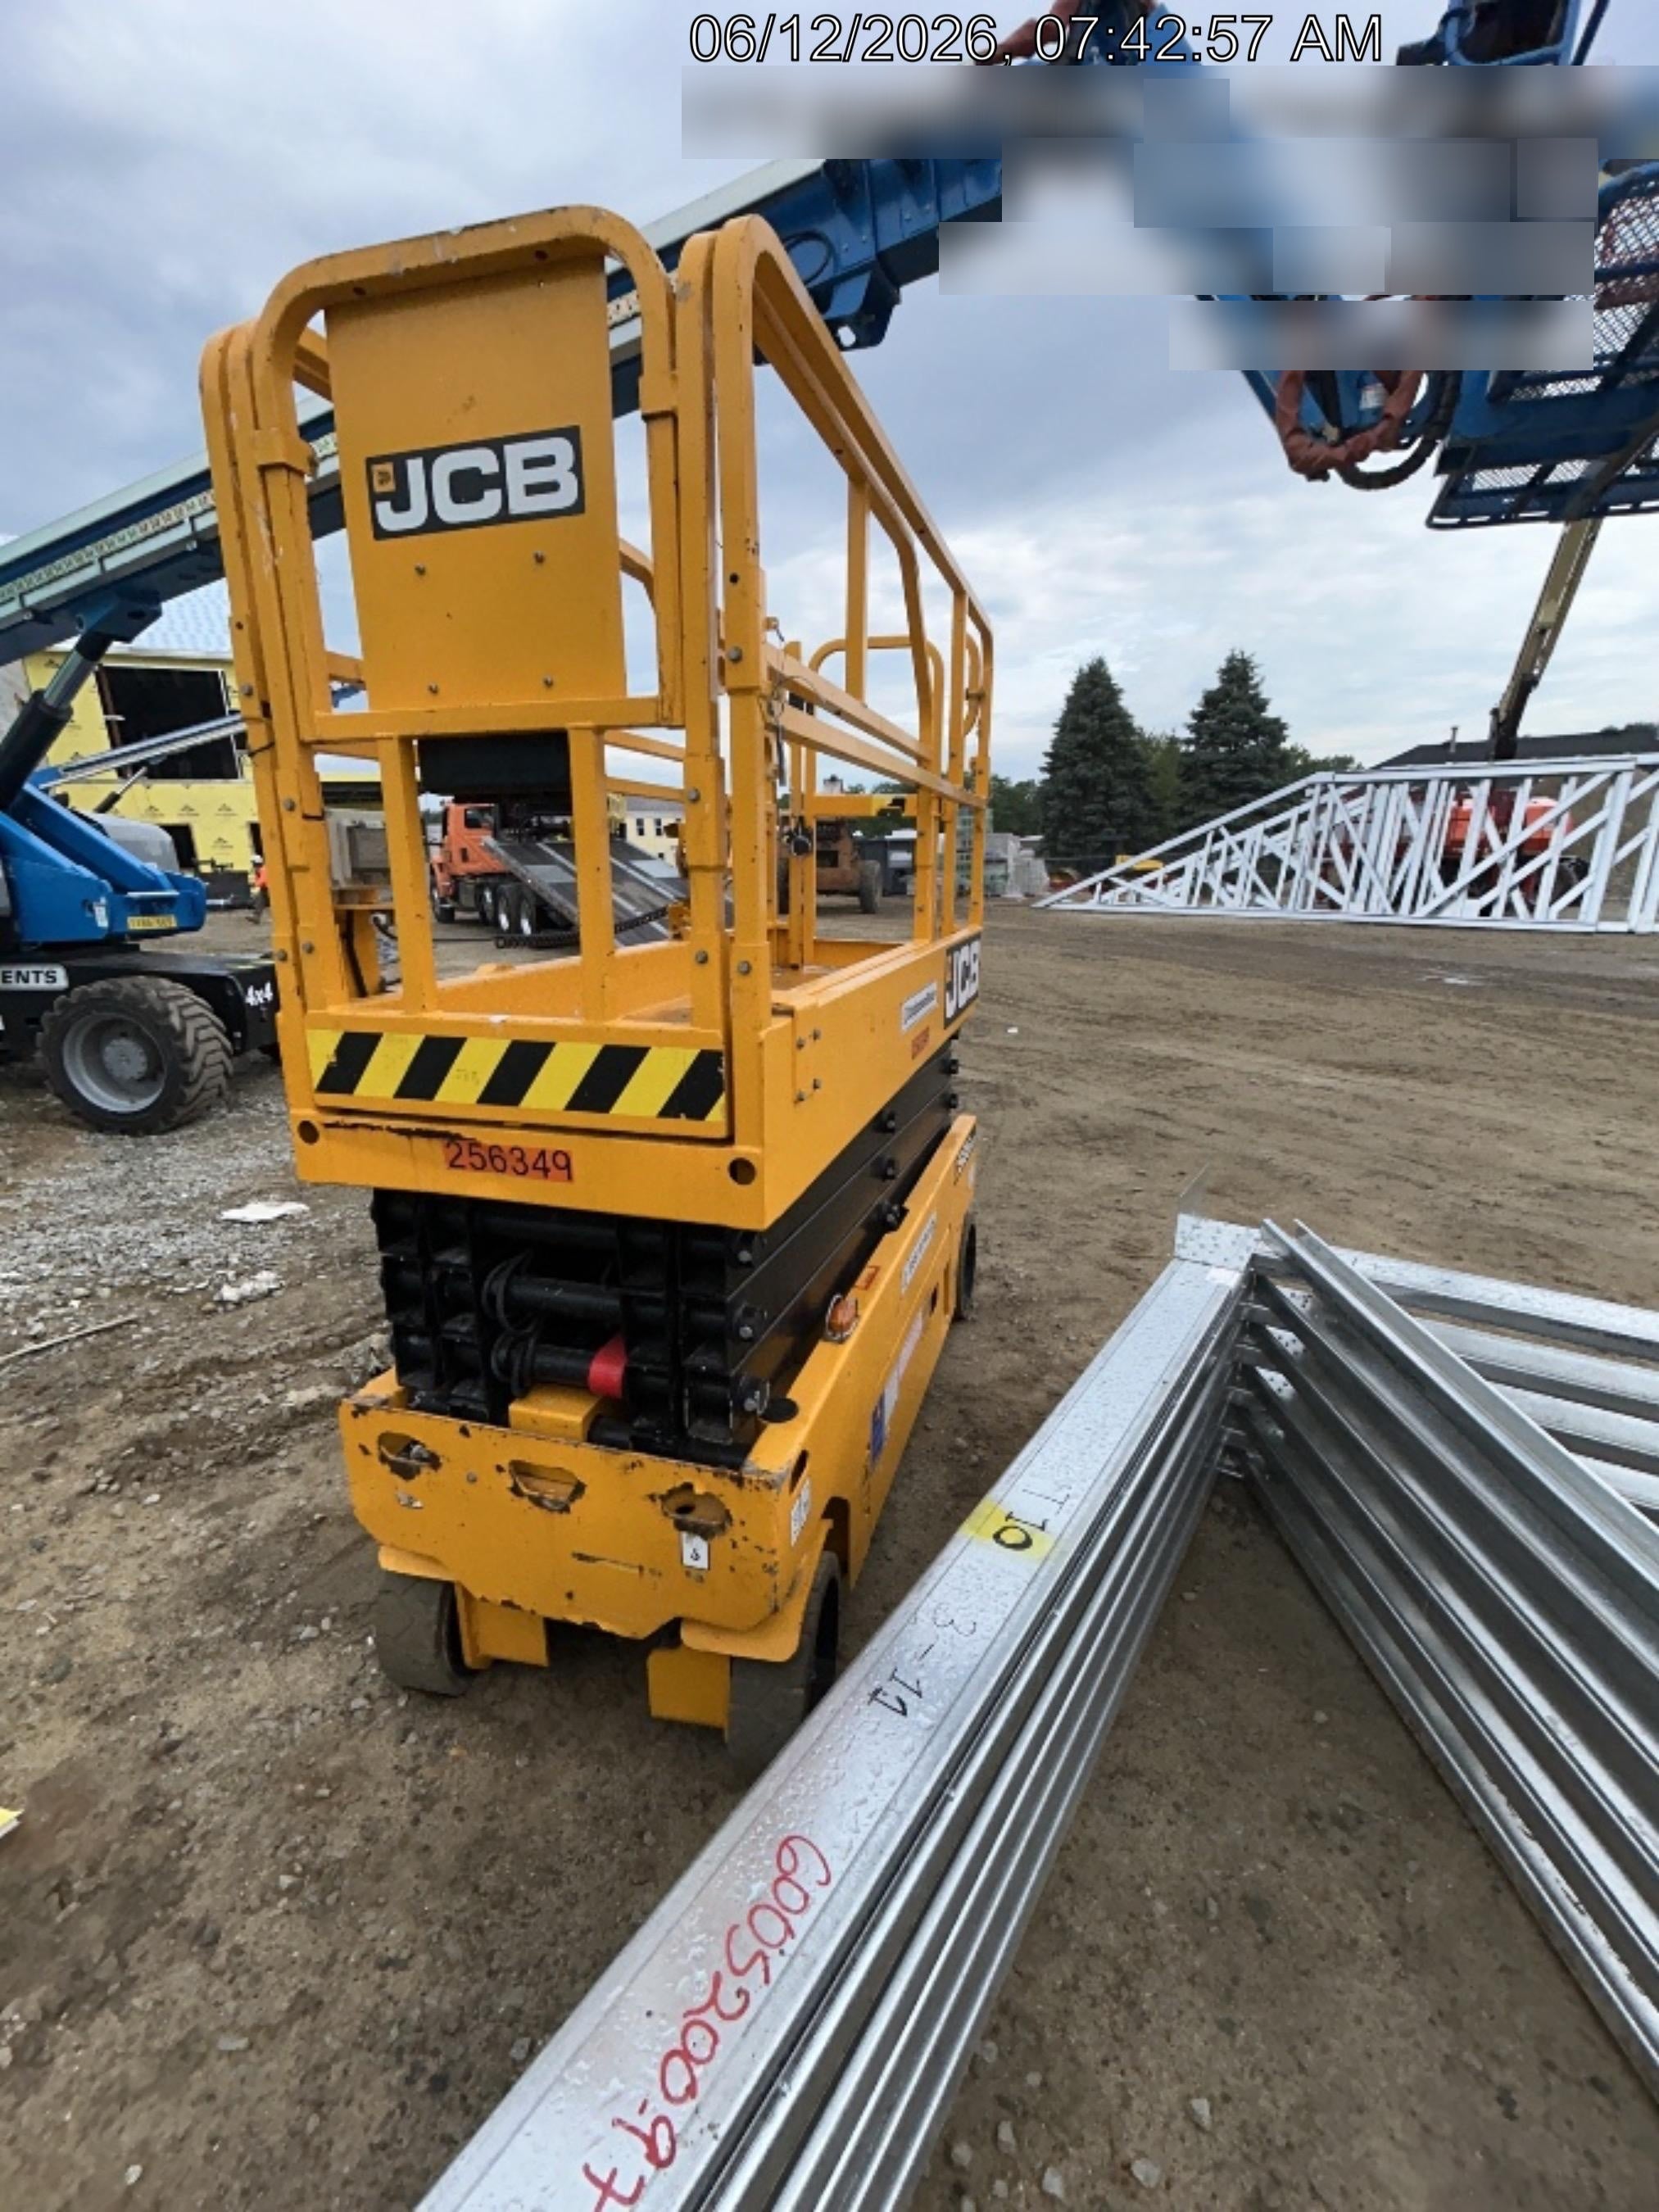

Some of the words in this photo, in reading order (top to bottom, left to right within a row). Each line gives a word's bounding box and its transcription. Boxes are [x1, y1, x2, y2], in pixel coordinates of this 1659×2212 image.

[374, 436, 579, 532] JCB
[945, 940, 981, 1018] JCB
[446, 1140, 573, 1181] 256349
